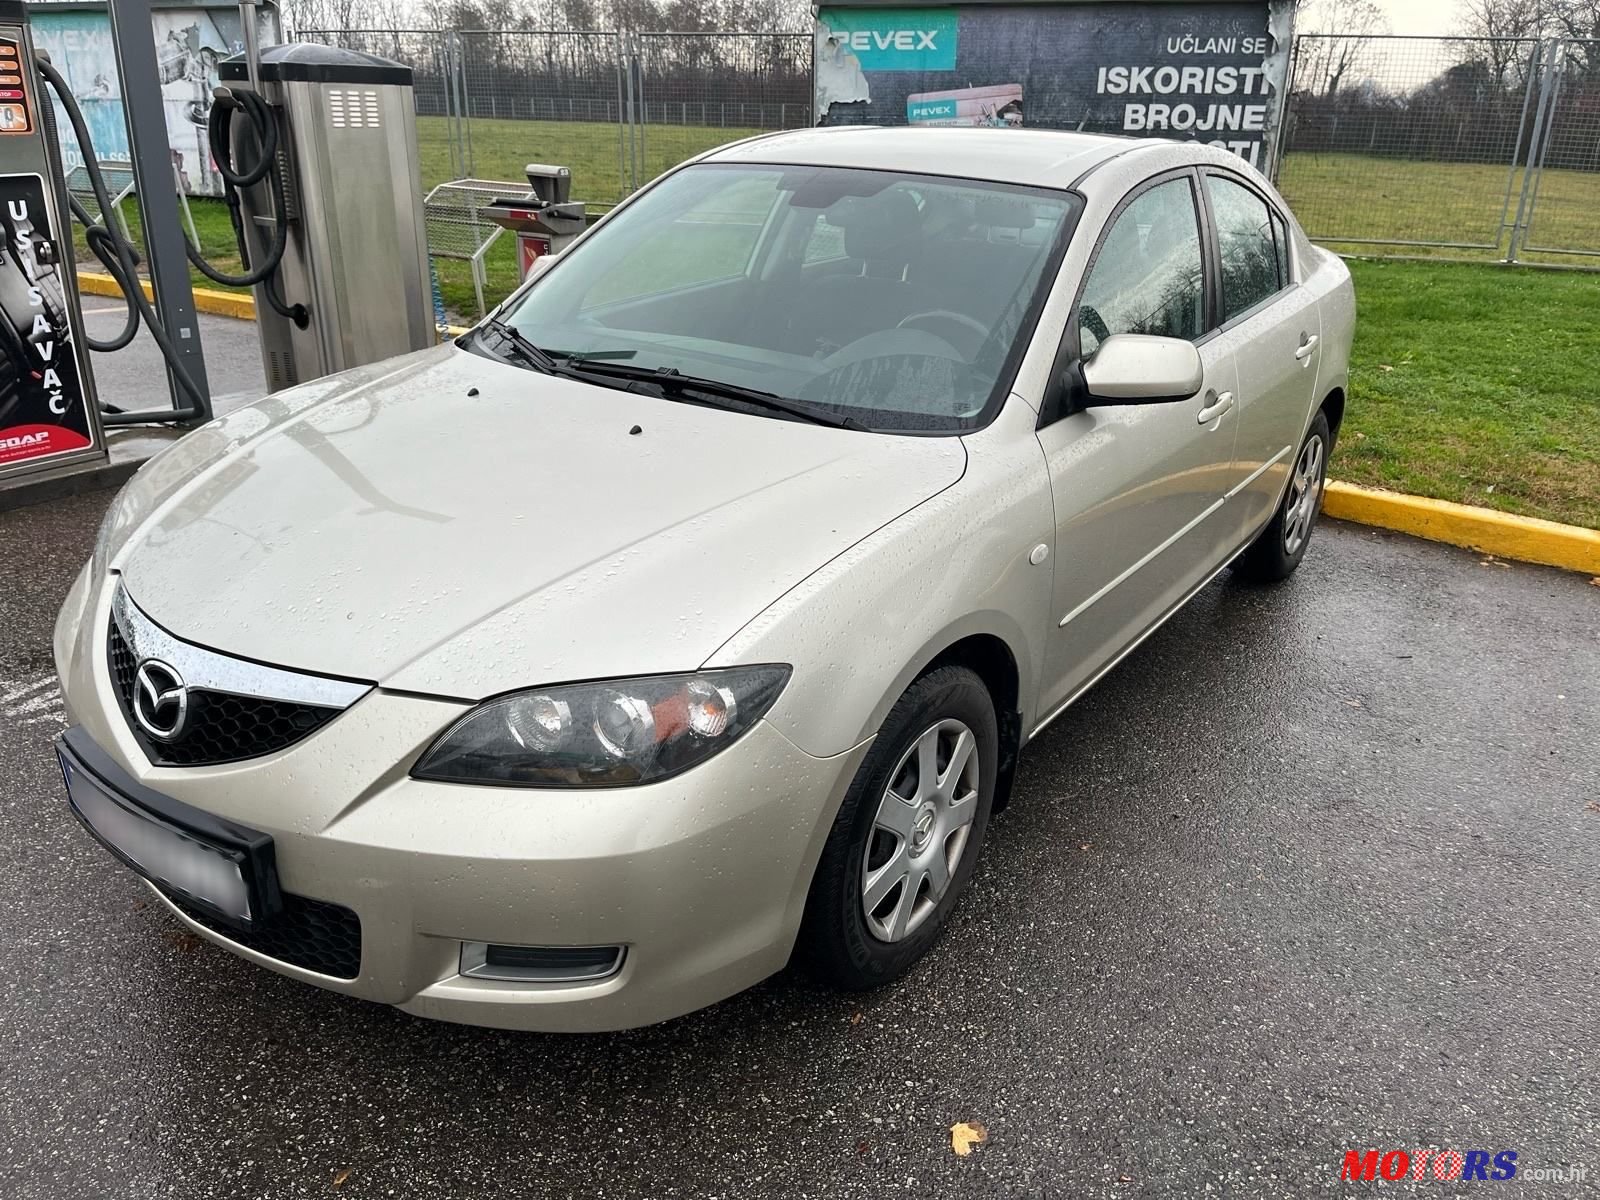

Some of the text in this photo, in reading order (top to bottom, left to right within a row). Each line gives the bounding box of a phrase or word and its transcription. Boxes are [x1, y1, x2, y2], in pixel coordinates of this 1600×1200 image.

[831, 31, 938, 50] PEVEX
[1167, 33, 1236, 54] UČLANI
[1241, 37, 1267, 54] SE
[1096, 66, 1271, 95] ISKORISTI
[912, 106, 951, 117] PEVEX
[1123, 103, 1267, 131] BROJNE
[8, 200, 65, 415] USISAVAČ
